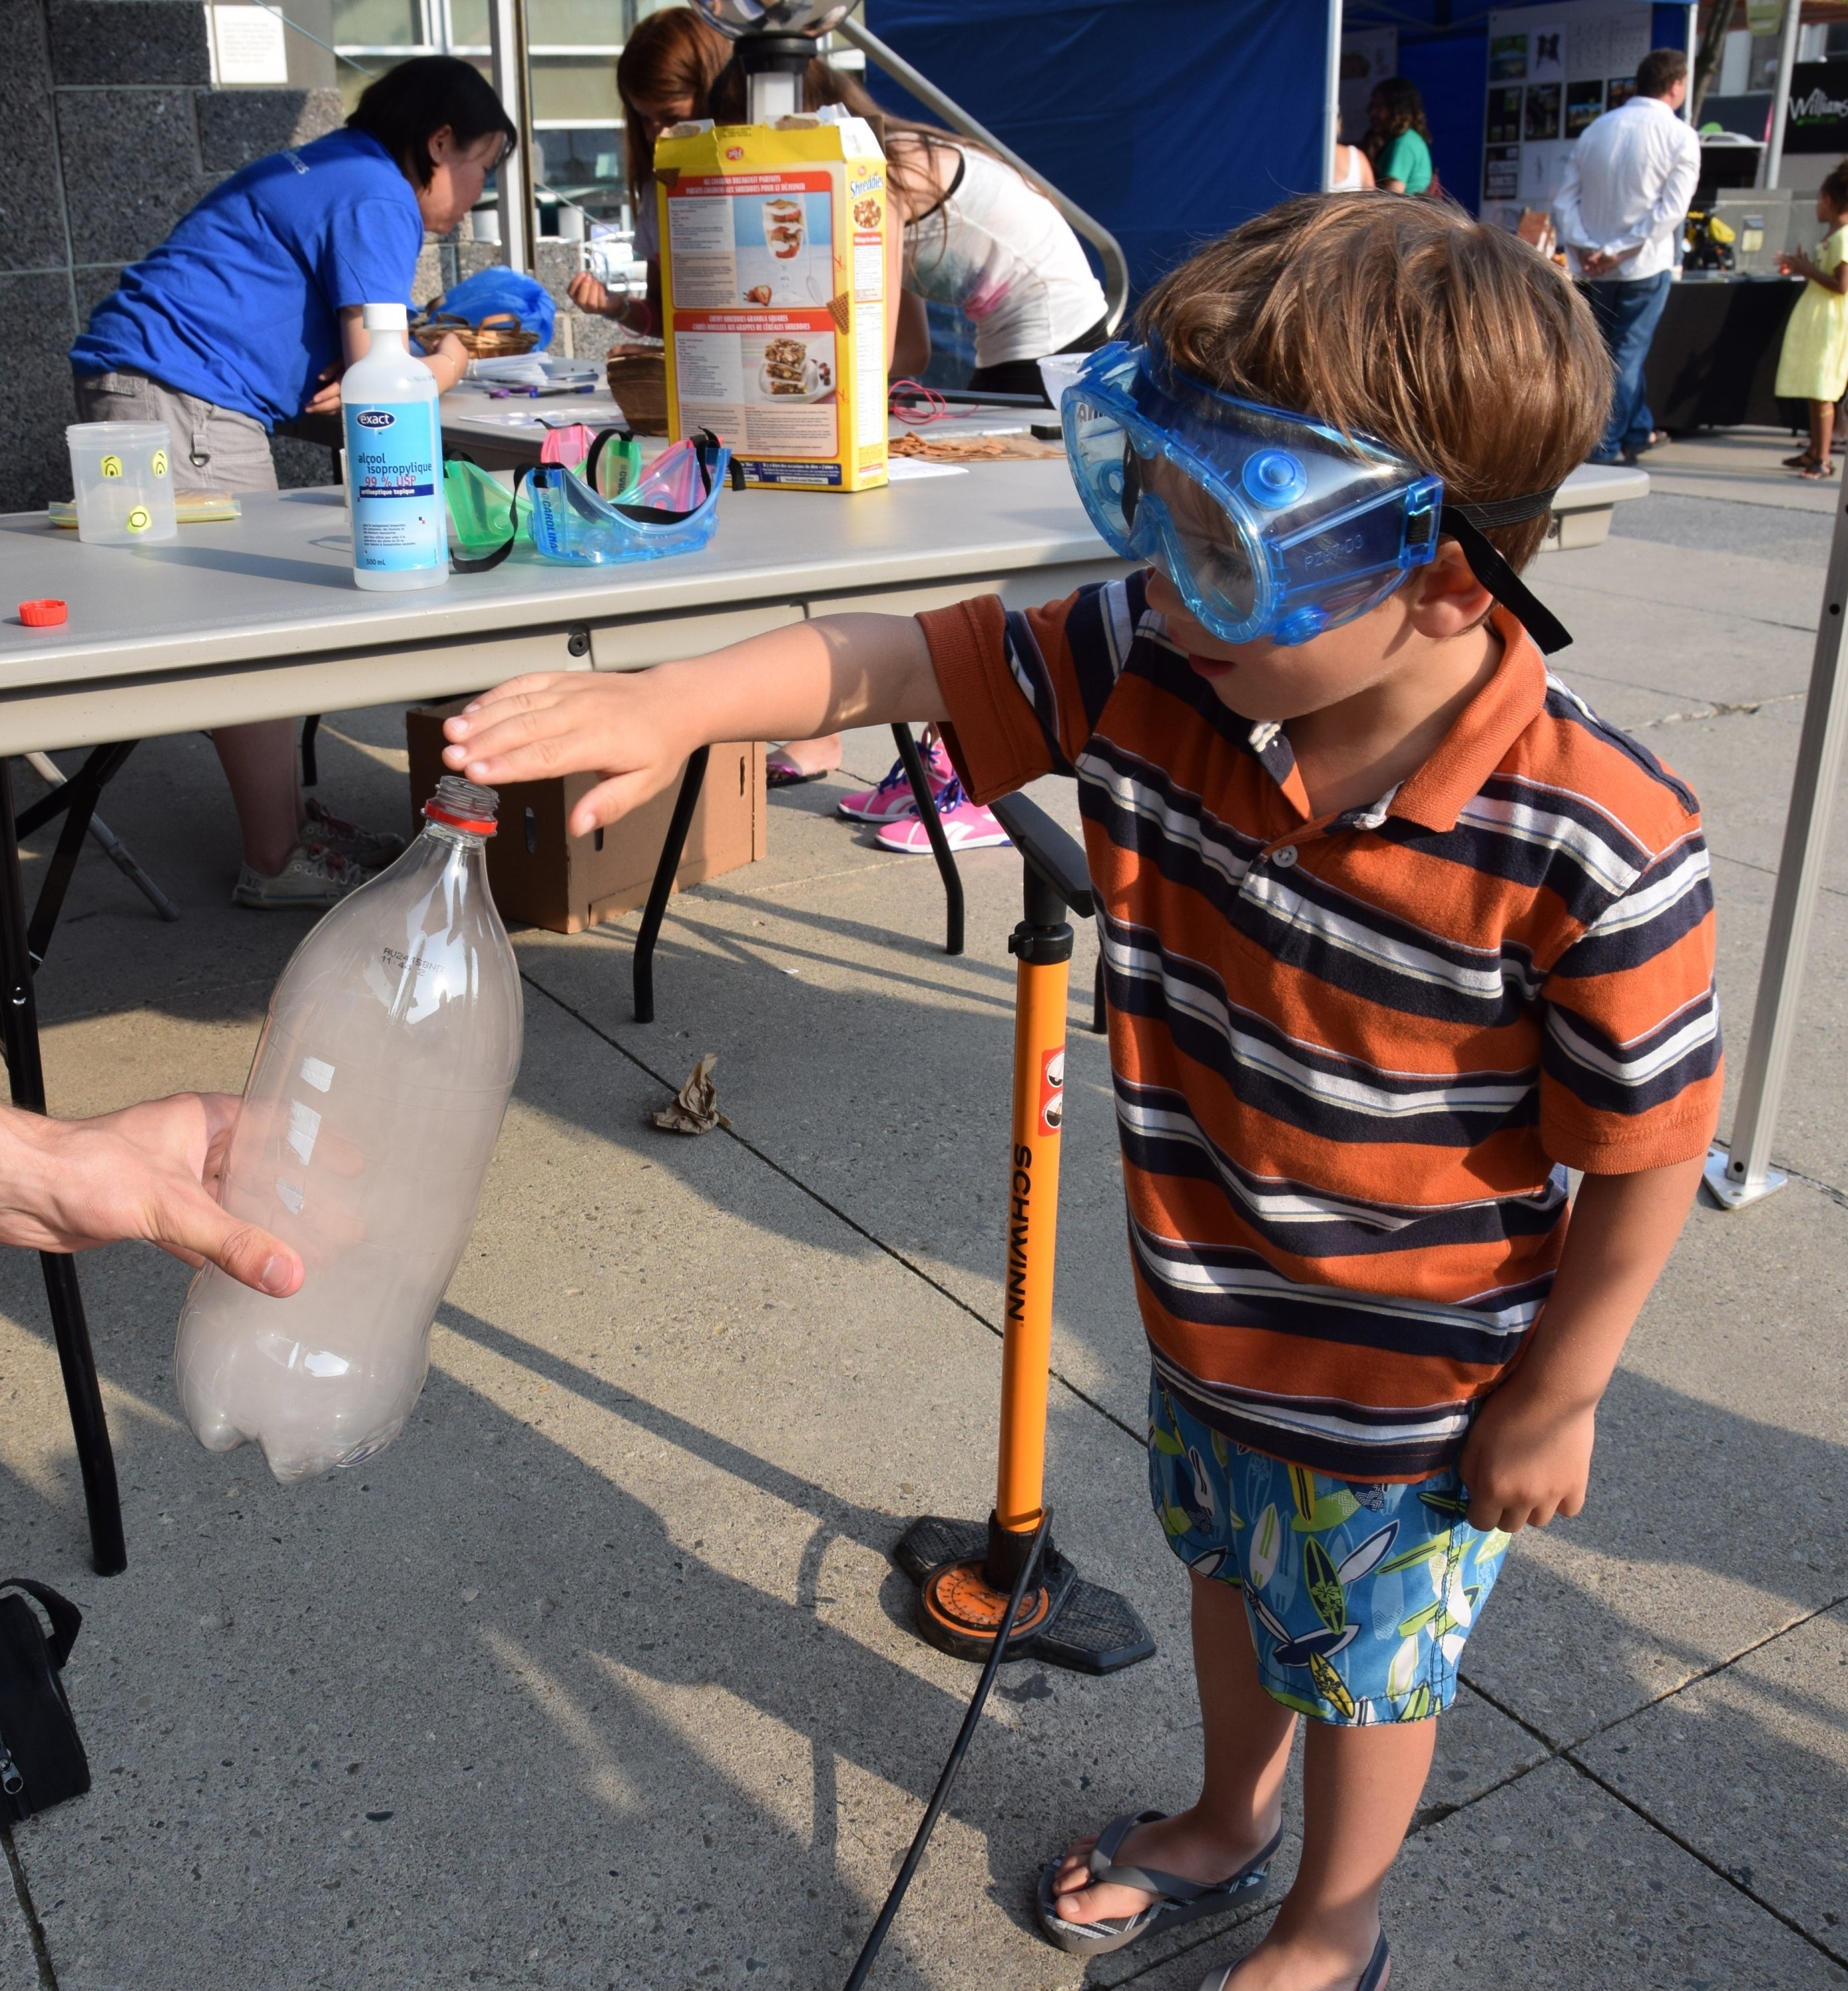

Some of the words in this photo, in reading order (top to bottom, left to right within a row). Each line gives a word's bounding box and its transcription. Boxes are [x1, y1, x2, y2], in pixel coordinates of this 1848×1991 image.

[850, 172, 884, 199] Shreddies
[360, 414, 390, 424] exact
[358, 453, 386, 464] alcool
[367, 463, 432, 476] isopropylique
[365, 477, 377, 487] 99
[381, 477, 391, 487] %
[396, 476, 416, 486] USP
[1007, 1143, 1032, 1321] SCHWINN
